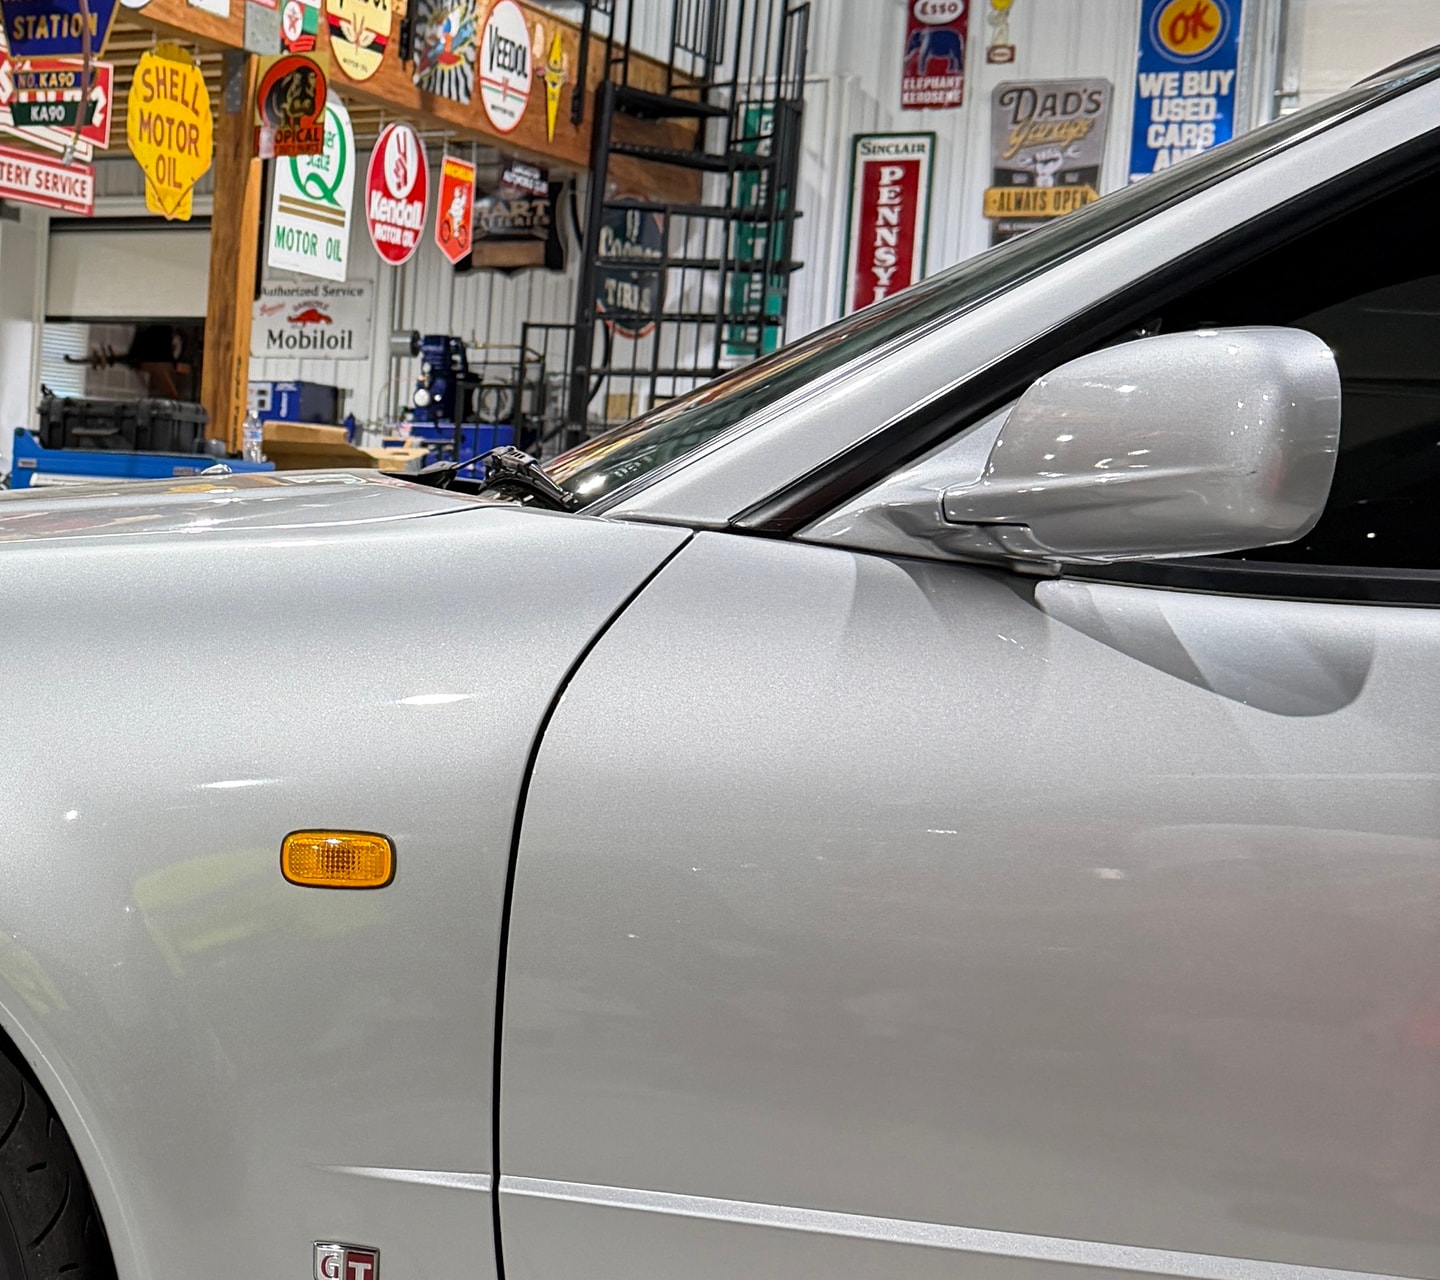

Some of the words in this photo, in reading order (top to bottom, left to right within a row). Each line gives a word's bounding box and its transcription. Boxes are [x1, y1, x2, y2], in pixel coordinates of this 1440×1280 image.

[920, 1, 959, 16] Esso
[1168, 0, 1214, 46] OK
[489, 23, 528, 80] VEEDOL
[141, 67, 202, 115] SHELL
[903, 76, 963, 89] ELEPHANT
[1139, 72, 1180, 99] WE
[1182, 69, 1235, 97] BUY
[30, 105, 66, 122] KA90
[999, 87, 1103, 124] DAD'S
[1150, 97, 1218, 123] USED
[138, 110, 201, 158] MOTOR
[273, 127, 320, 145] OPICAL
[1146, 123, 1216, 149] CARS
[35, 171, 87, 198] SERVICE
[155, 156, 183, 190] OIL
[370, 190, 423, 231] Kendall
[997, 192, 1047, 212] ALWAYS
[1053, 190, 1089, 211] OPEN
[274, 225, 318, 256] MOTOR
[326, 238, 342, 262] OIL
[374, 226, 401, 243] MOTOR
[261, 285, 319, 297] Authorized
[322, 286, 364, 297] Service
[266, 329, 353, 350] Mobiloil
